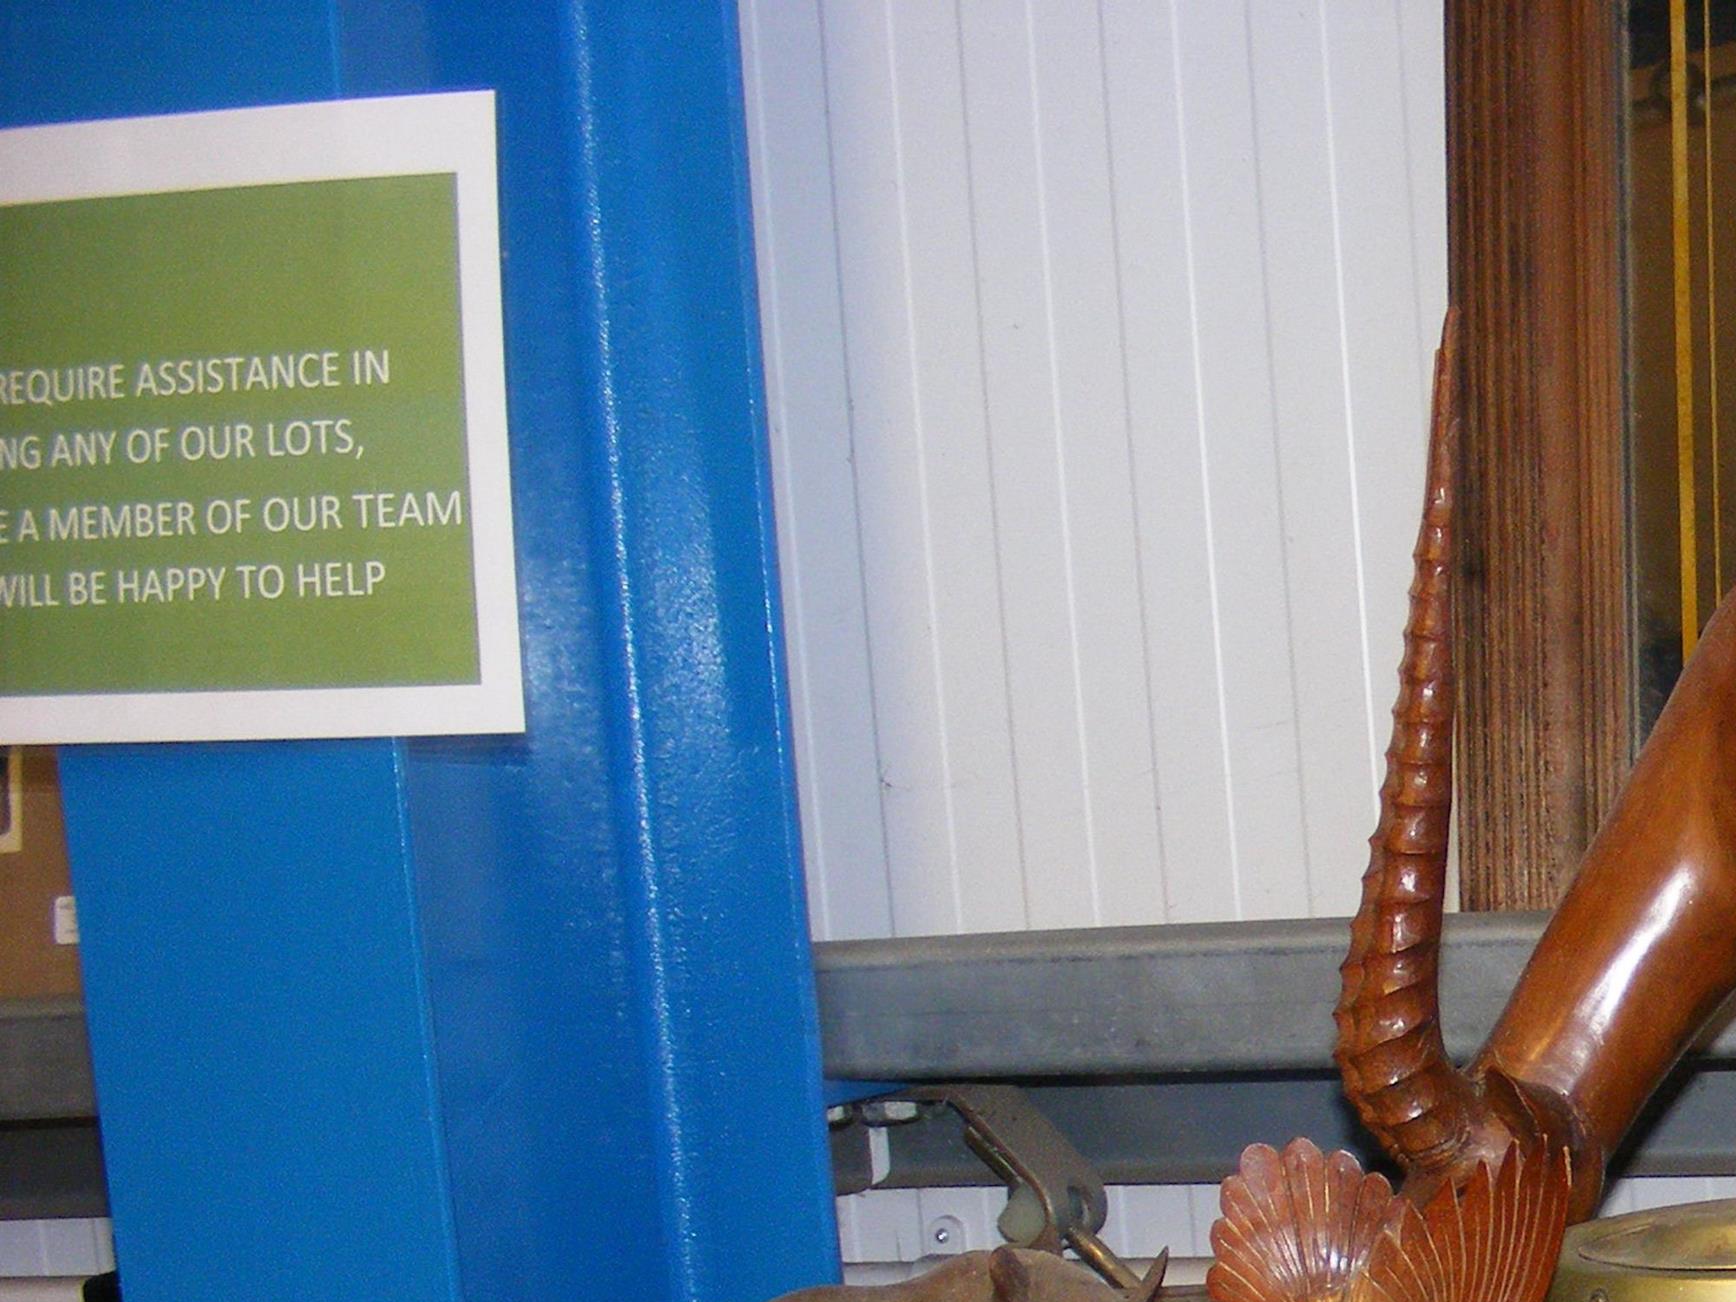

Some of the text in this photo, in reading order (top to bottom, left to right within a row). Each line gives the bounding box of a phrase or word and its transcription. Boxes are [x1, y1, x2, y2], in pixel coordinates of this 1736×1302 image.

[135, 351, 341, 397] ASSISTANCE
[352, 348, 390, 385] IN
[51, 431, 117, 467] ANY
[126, 427, 170, 463] OF
[180, 423, 256, 460] OUR
[267, 418, 364, 460] LOTS,
[18, 508, 40, 542] A
[49, 501, 196, 541] MEMBER
[206, 498, 252, 534] OF
[263, 495, 343, 532] OUR
[352, 490, 463, 529] TEAM
[68, 571, 107, 606] BE
[117, 566, 226, 603] HAPPY
[235, 563, 285, 599] TO
[297, 560, 386, 597] HELP
